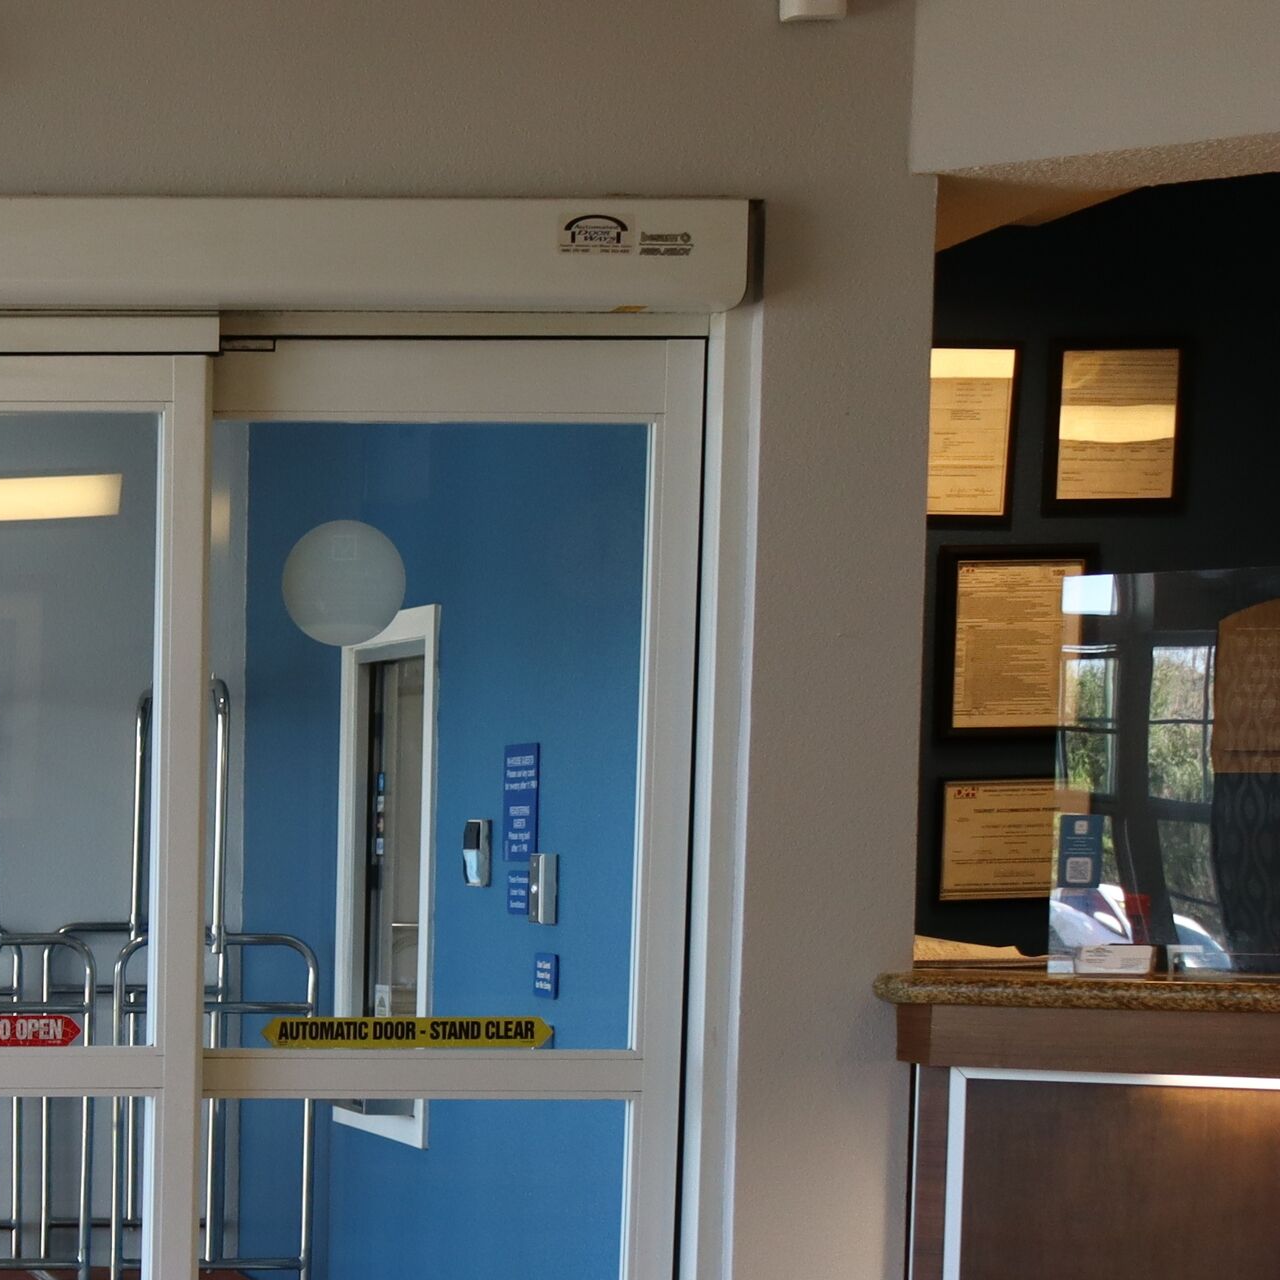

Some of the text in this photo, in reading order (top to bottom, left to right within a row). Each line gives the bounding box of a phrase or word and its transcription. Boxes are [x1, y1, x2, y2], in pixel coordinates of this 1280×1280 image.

[15, 1019, 63, 1040] OPEN
[278, 1021, 368, 1041] AUTOMATIC
[372, 1021, 416, 1041] DOOR
[430, 1021, 481, 1040] STAND
[485, 1021, 535, 1040] CLEAR
